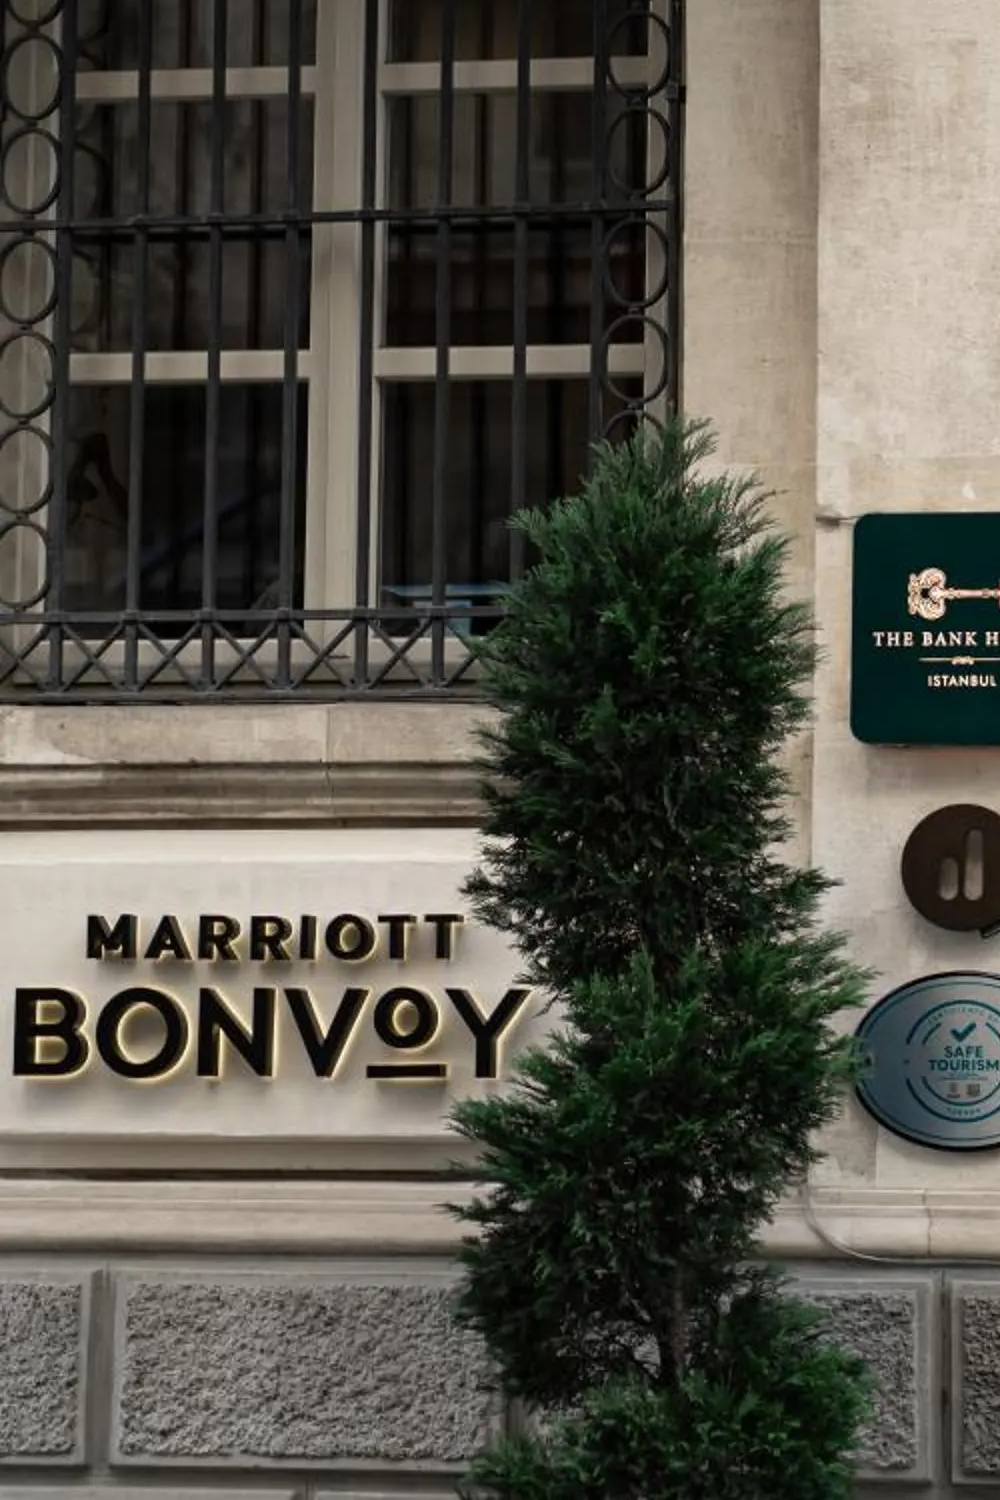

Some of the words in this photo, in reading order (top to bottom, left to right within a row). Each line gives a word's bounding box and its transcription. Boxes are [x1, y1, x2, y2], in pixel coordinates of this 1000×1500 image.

[872, 631, 914, 647] THE
[922, 631, 977, 647] BANK
[927, 675, 997, 687] ISTANBUL
[86, 914, 464, 961] MARRIOTT
[13, 987, 531, 1079] BONVOY
[943, 1045, 983, 1058] SAFE
[928, 1059, 1000, 1072] TOURISM
